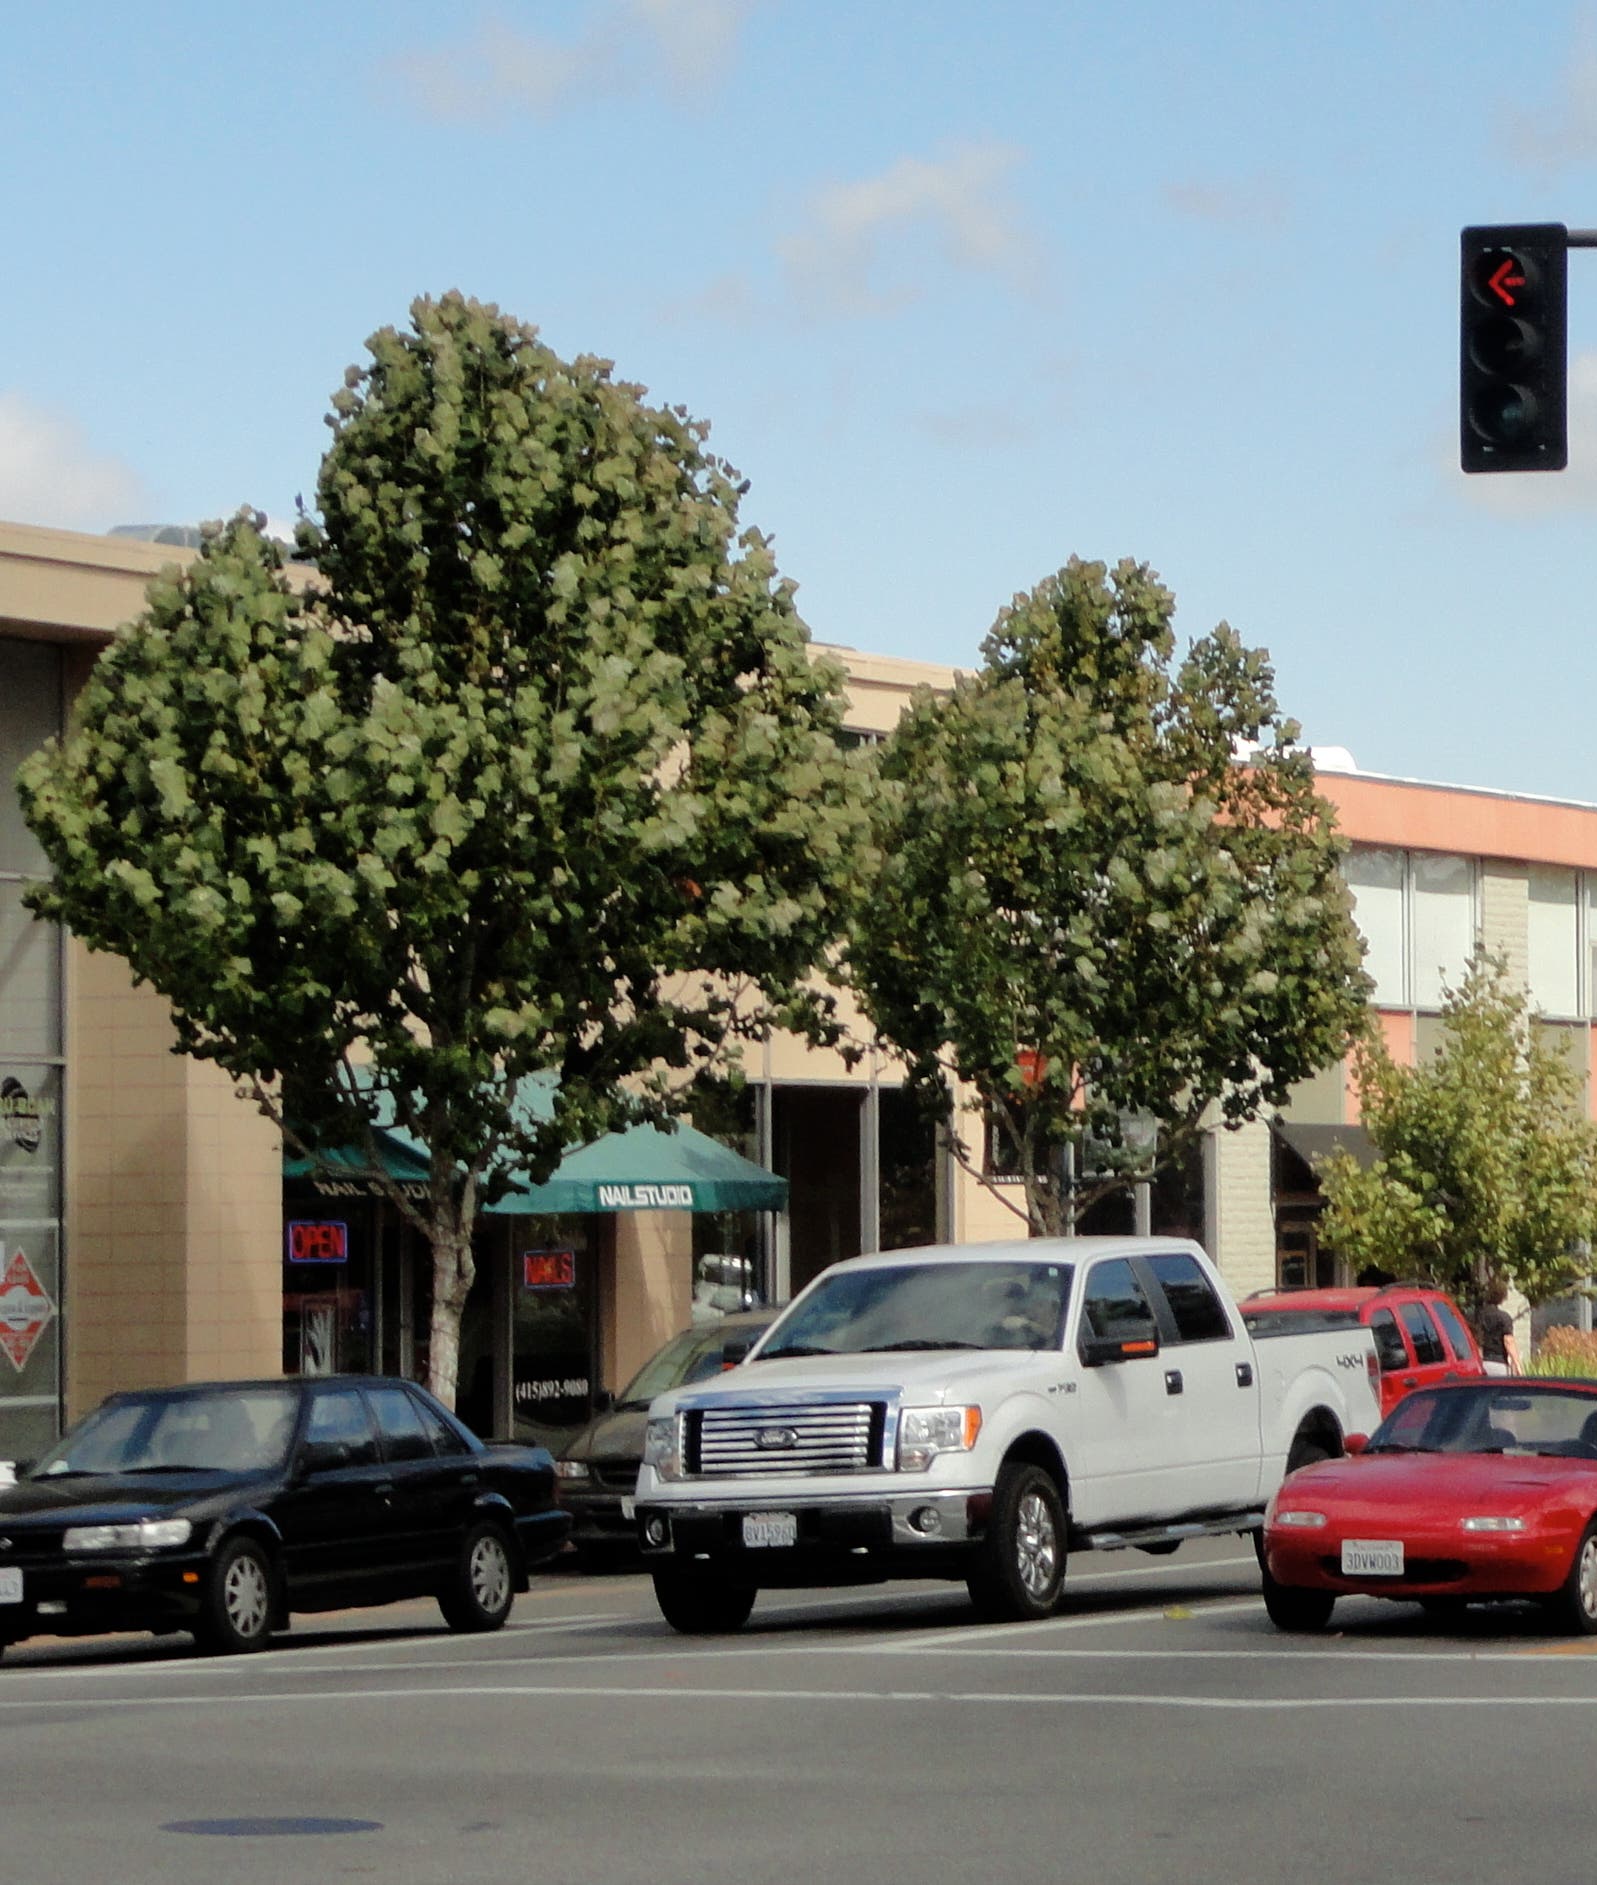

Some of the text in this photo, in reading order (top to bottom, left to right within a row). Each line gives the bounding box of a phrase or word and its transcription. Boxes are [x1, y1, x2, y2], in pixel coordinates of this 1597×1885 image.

[313, 1181, 367, 1196] NAIL
[292, 1225, 345, 1259] OPEN
[1346, 1551, 1400, 1570] 3DVW003
